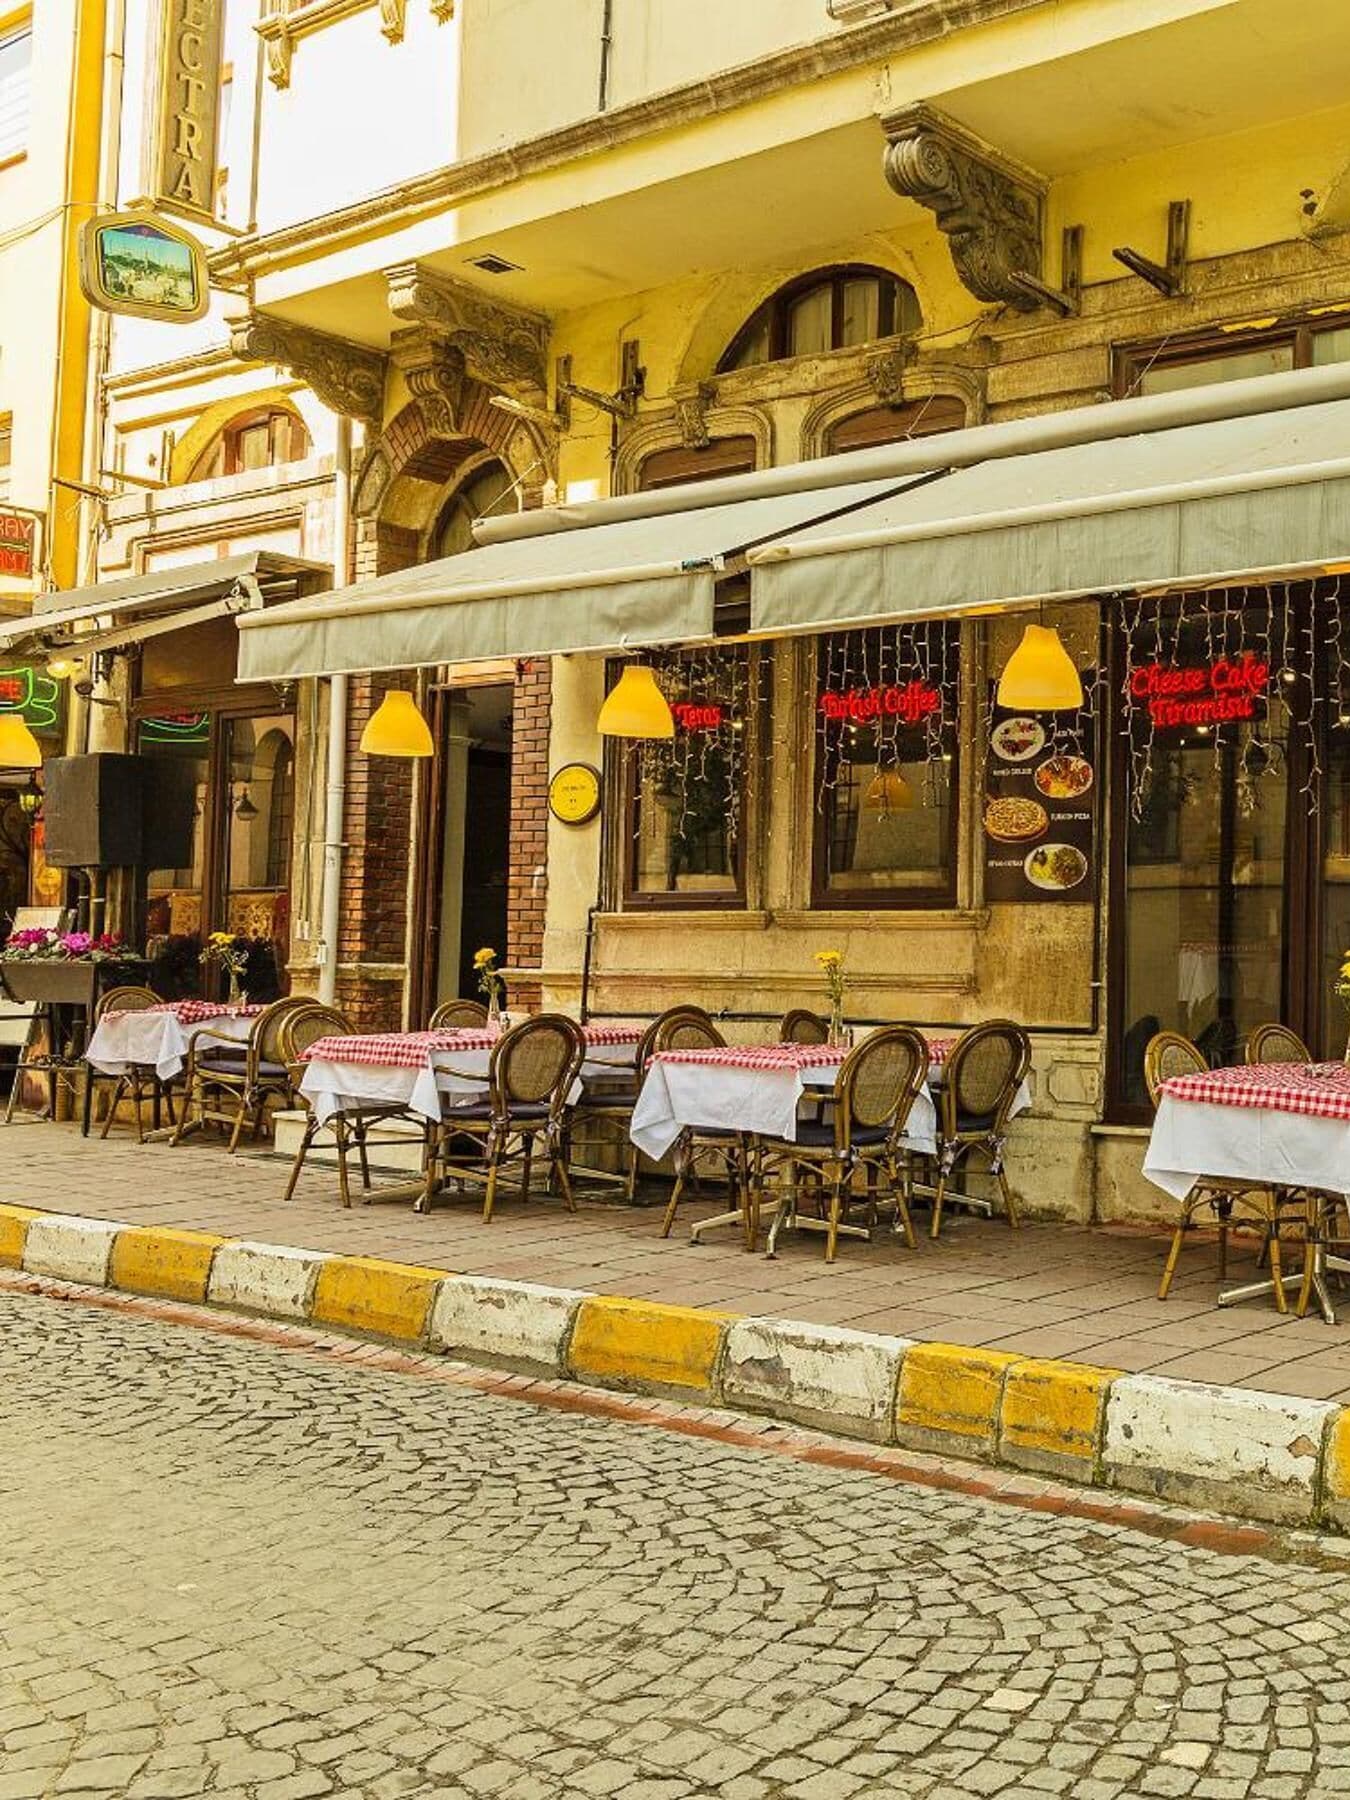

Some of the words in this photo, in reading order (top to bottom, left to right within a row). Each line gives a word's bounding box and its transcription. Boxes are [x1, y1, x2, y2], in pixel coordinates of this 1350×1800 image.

[1131, 662, 1205, 697] Cheese
[1211, 651, 1268, 694] Cake
[884, 680, 939, 722] Coffee
[1149, 693, 1254, 727] Tiramisu
